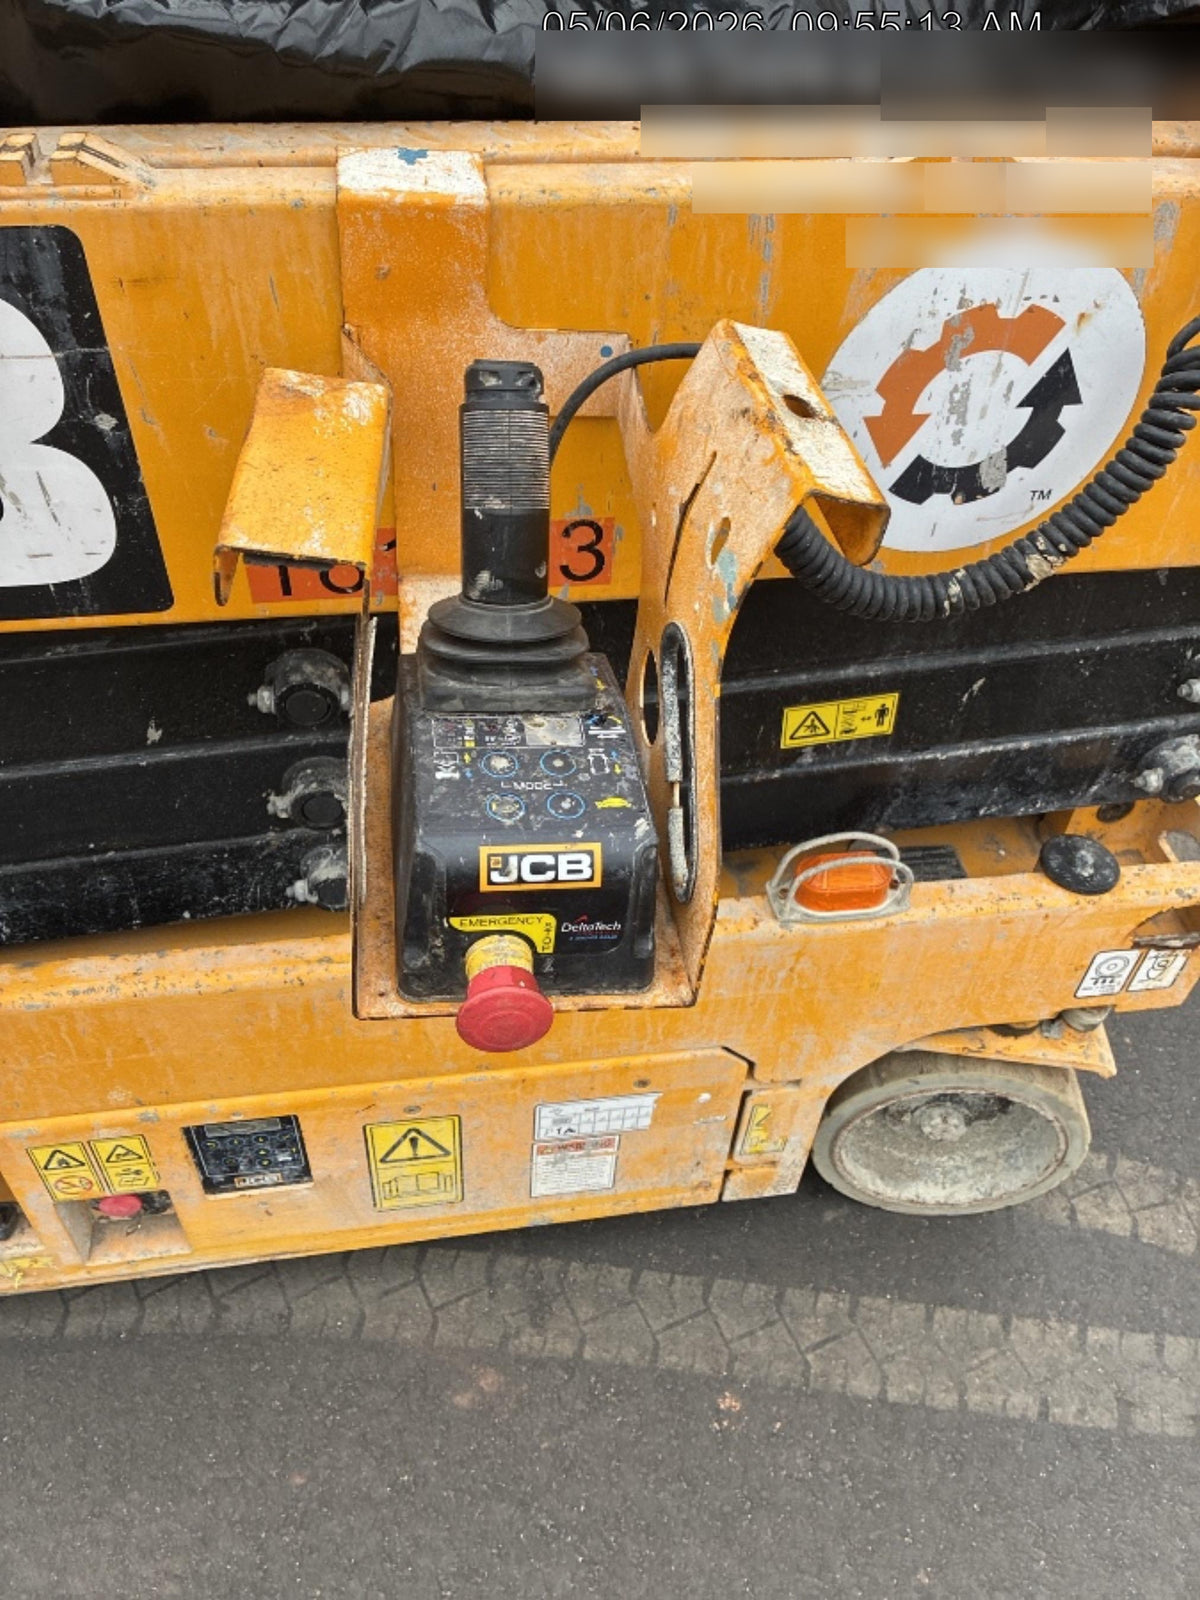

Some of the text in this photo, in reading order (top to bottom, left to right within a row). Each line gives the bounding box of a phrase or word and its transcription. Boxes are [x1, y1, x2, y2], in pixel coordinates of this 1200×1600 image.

[1029, 489, 1052, 502] TM
[489, 852, 594, 884] JCB
[458, 915, 544, 928] EMERGENCY
